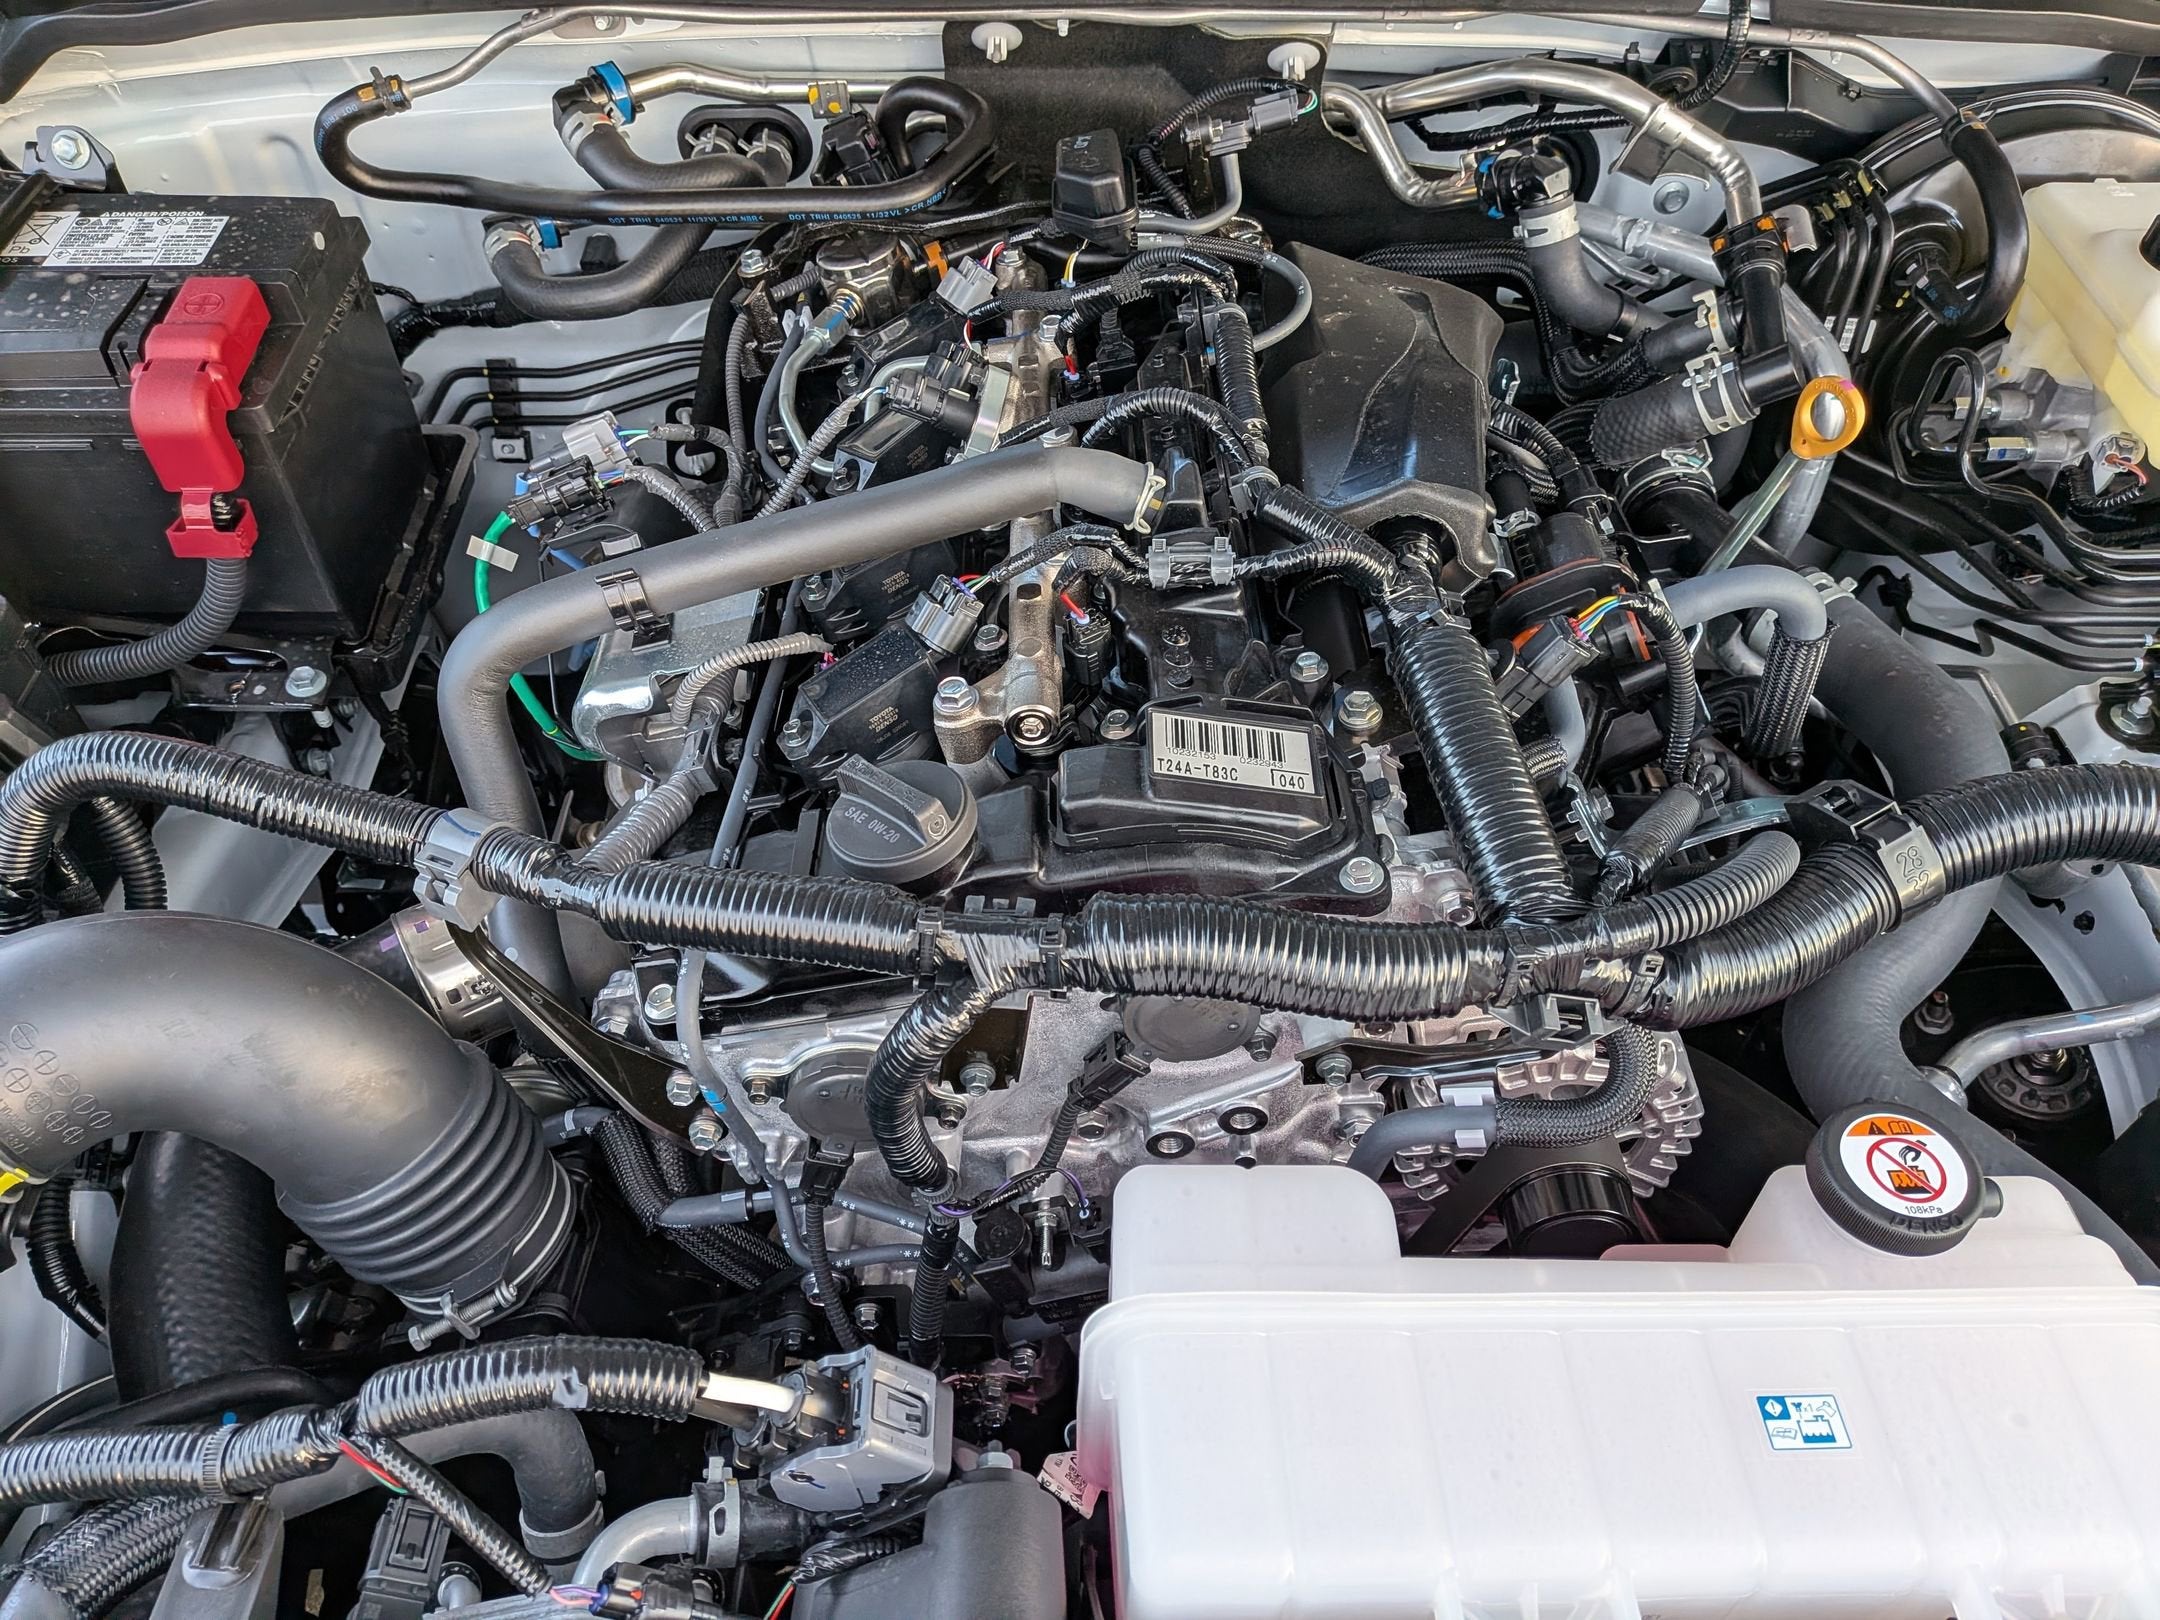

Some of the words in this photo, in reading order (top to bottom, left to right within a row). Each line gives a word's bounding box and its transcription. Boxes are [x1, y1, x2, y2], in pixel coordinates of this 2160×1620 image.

[608, 216, 626, 224] DOT
[789, 213, 806, 221] DOT
[8, 246, 31, 254] Pb
[882, 570, 906, 585] TOYOTA
[887, 578, 910, 593] DENSO
[868, 706, 894, 723] TOYOTA
[875, 714, 899, 733] DENSO
[1167, 747, 1216, 760] 10232153
[1240, 757, 1285, 769] 0232943
[1157, 758, 1239, 781] T24A-T83C
[844, 806, 868, 824] SAE
[867, 820, 900, 843] 0W-20
[1896, 845, 1923, 877] 28
[1906, 869, 1935, 900] 32
[1905, 1206, 1943, 1214] 108kPa
[1889, 1214, 1963, 1234] DENSO
